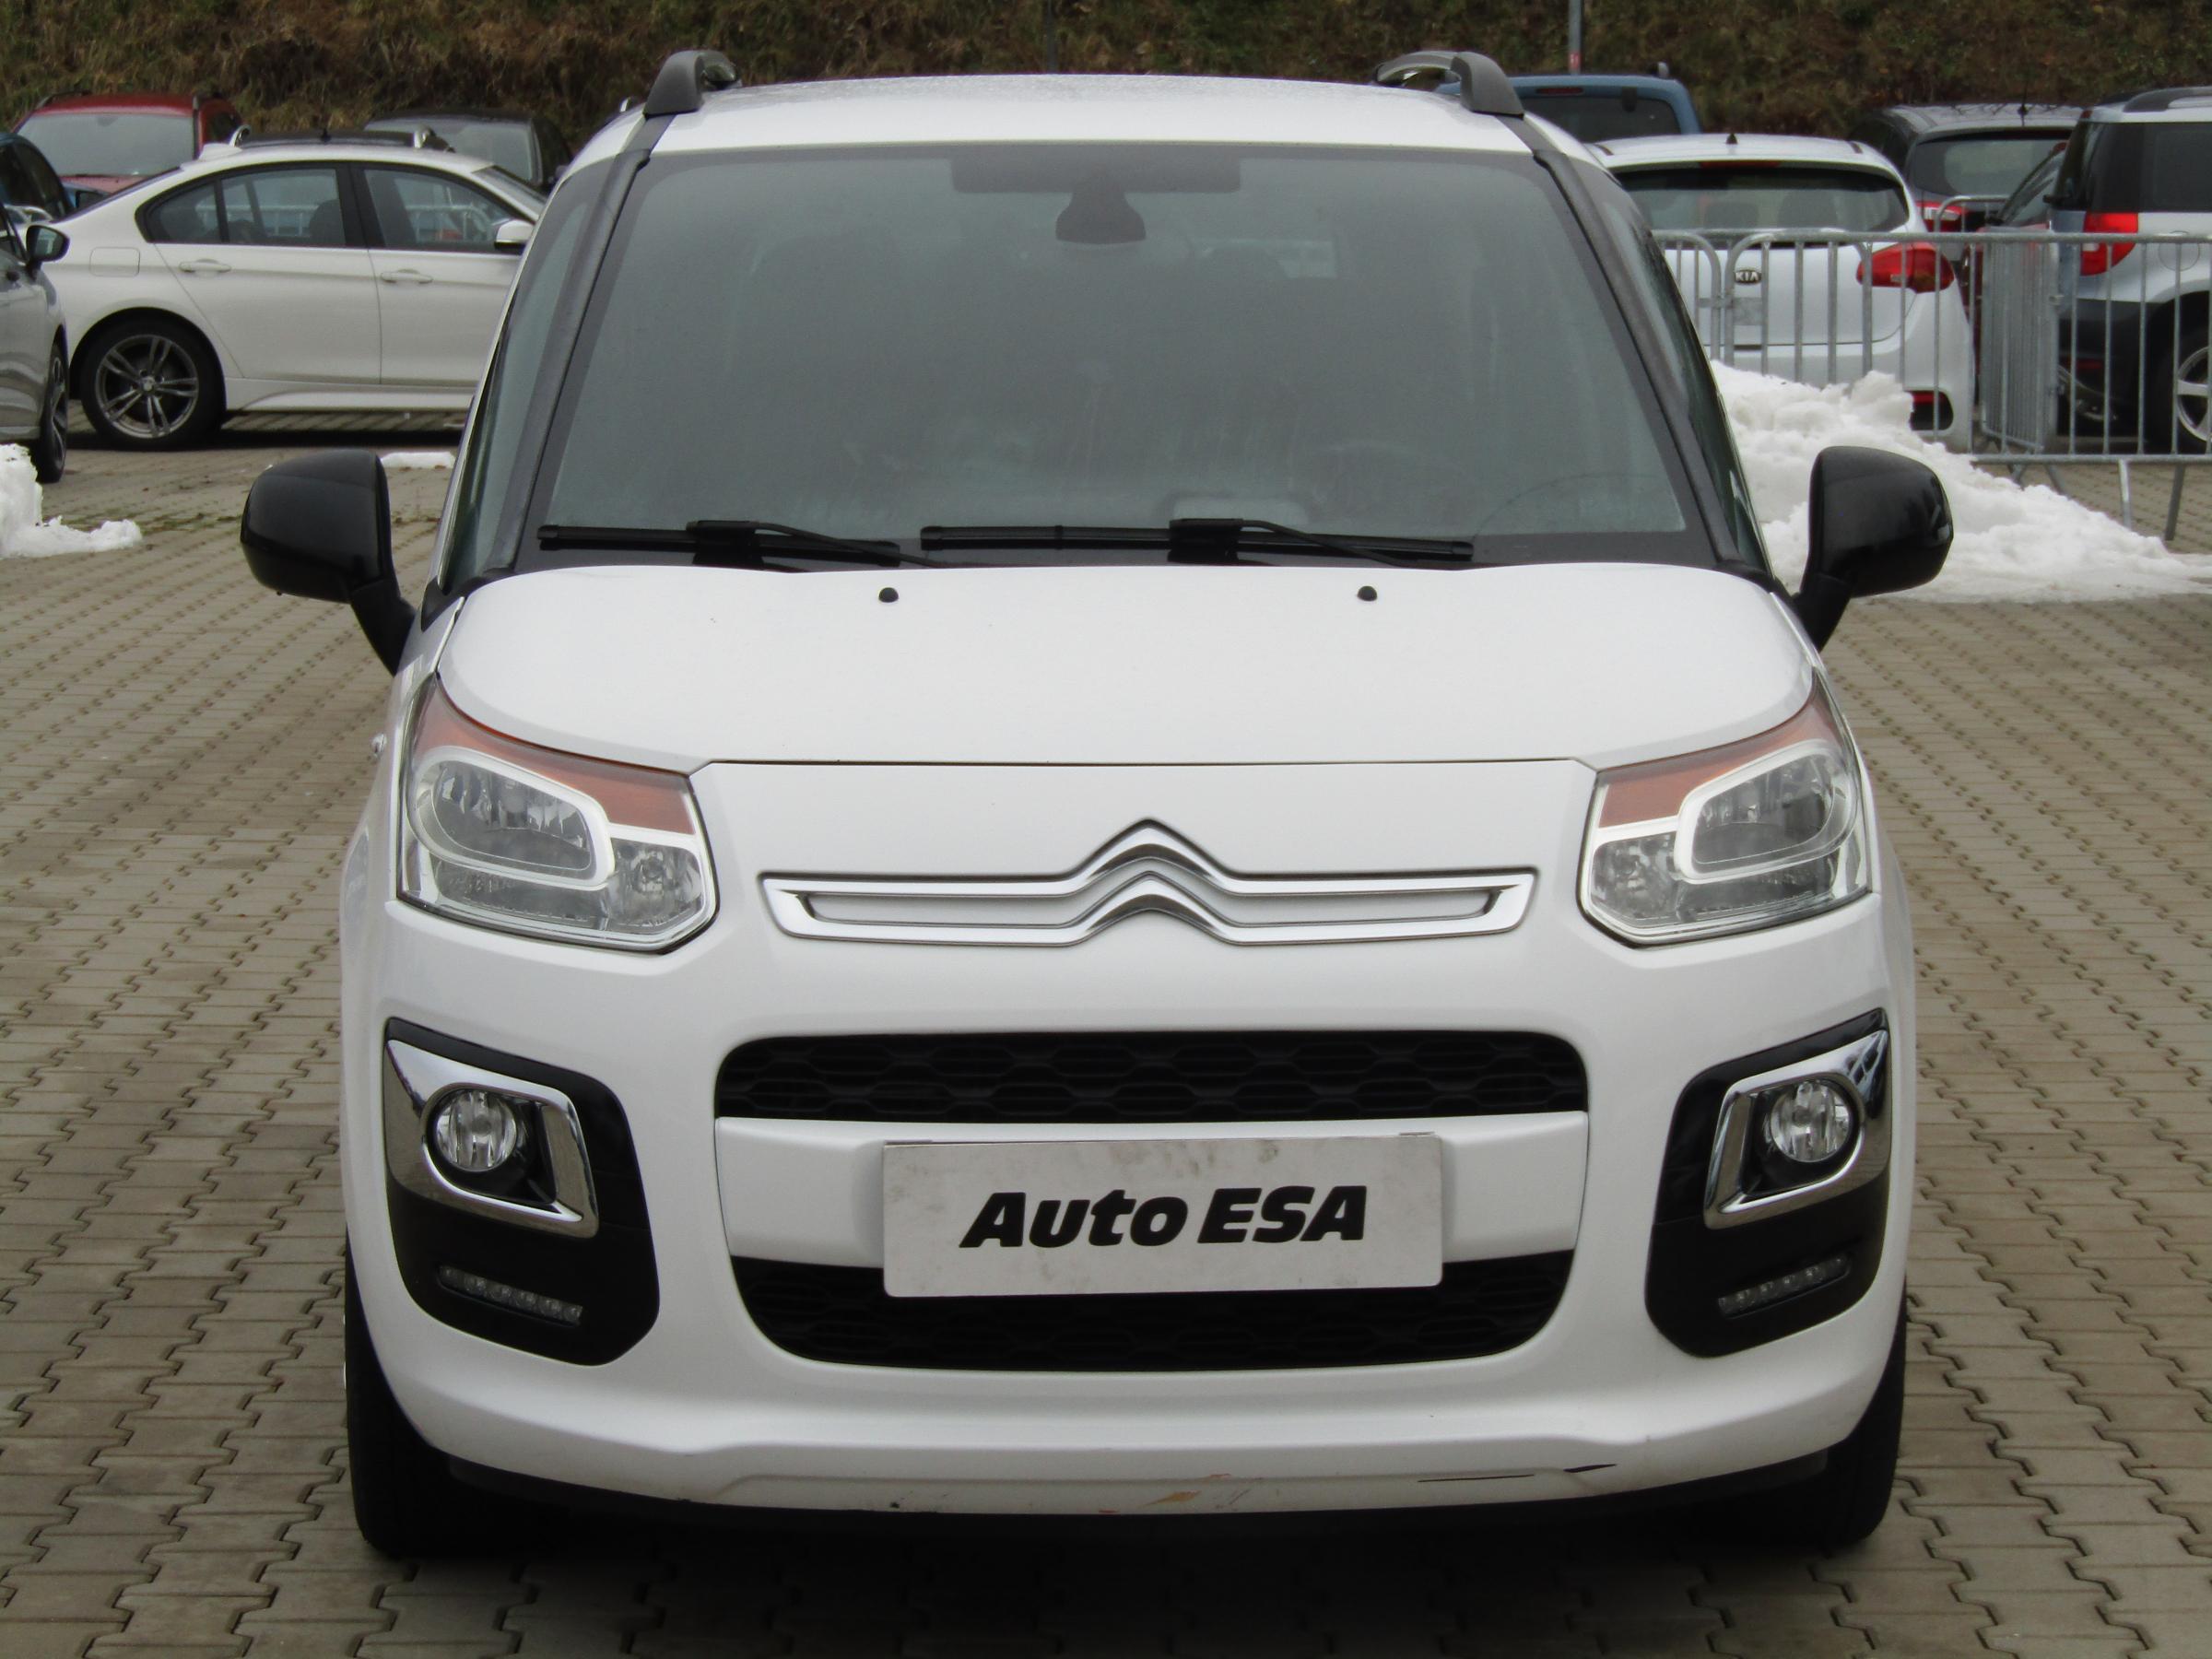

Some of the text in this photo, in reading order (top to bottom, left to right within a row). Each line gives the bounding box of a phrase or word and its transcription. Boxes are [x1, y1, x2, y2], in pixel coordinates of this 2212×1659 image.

[1735, 271, 1759, 282] KIA
[959, 1185, 1368, 1249] Auto ESA
